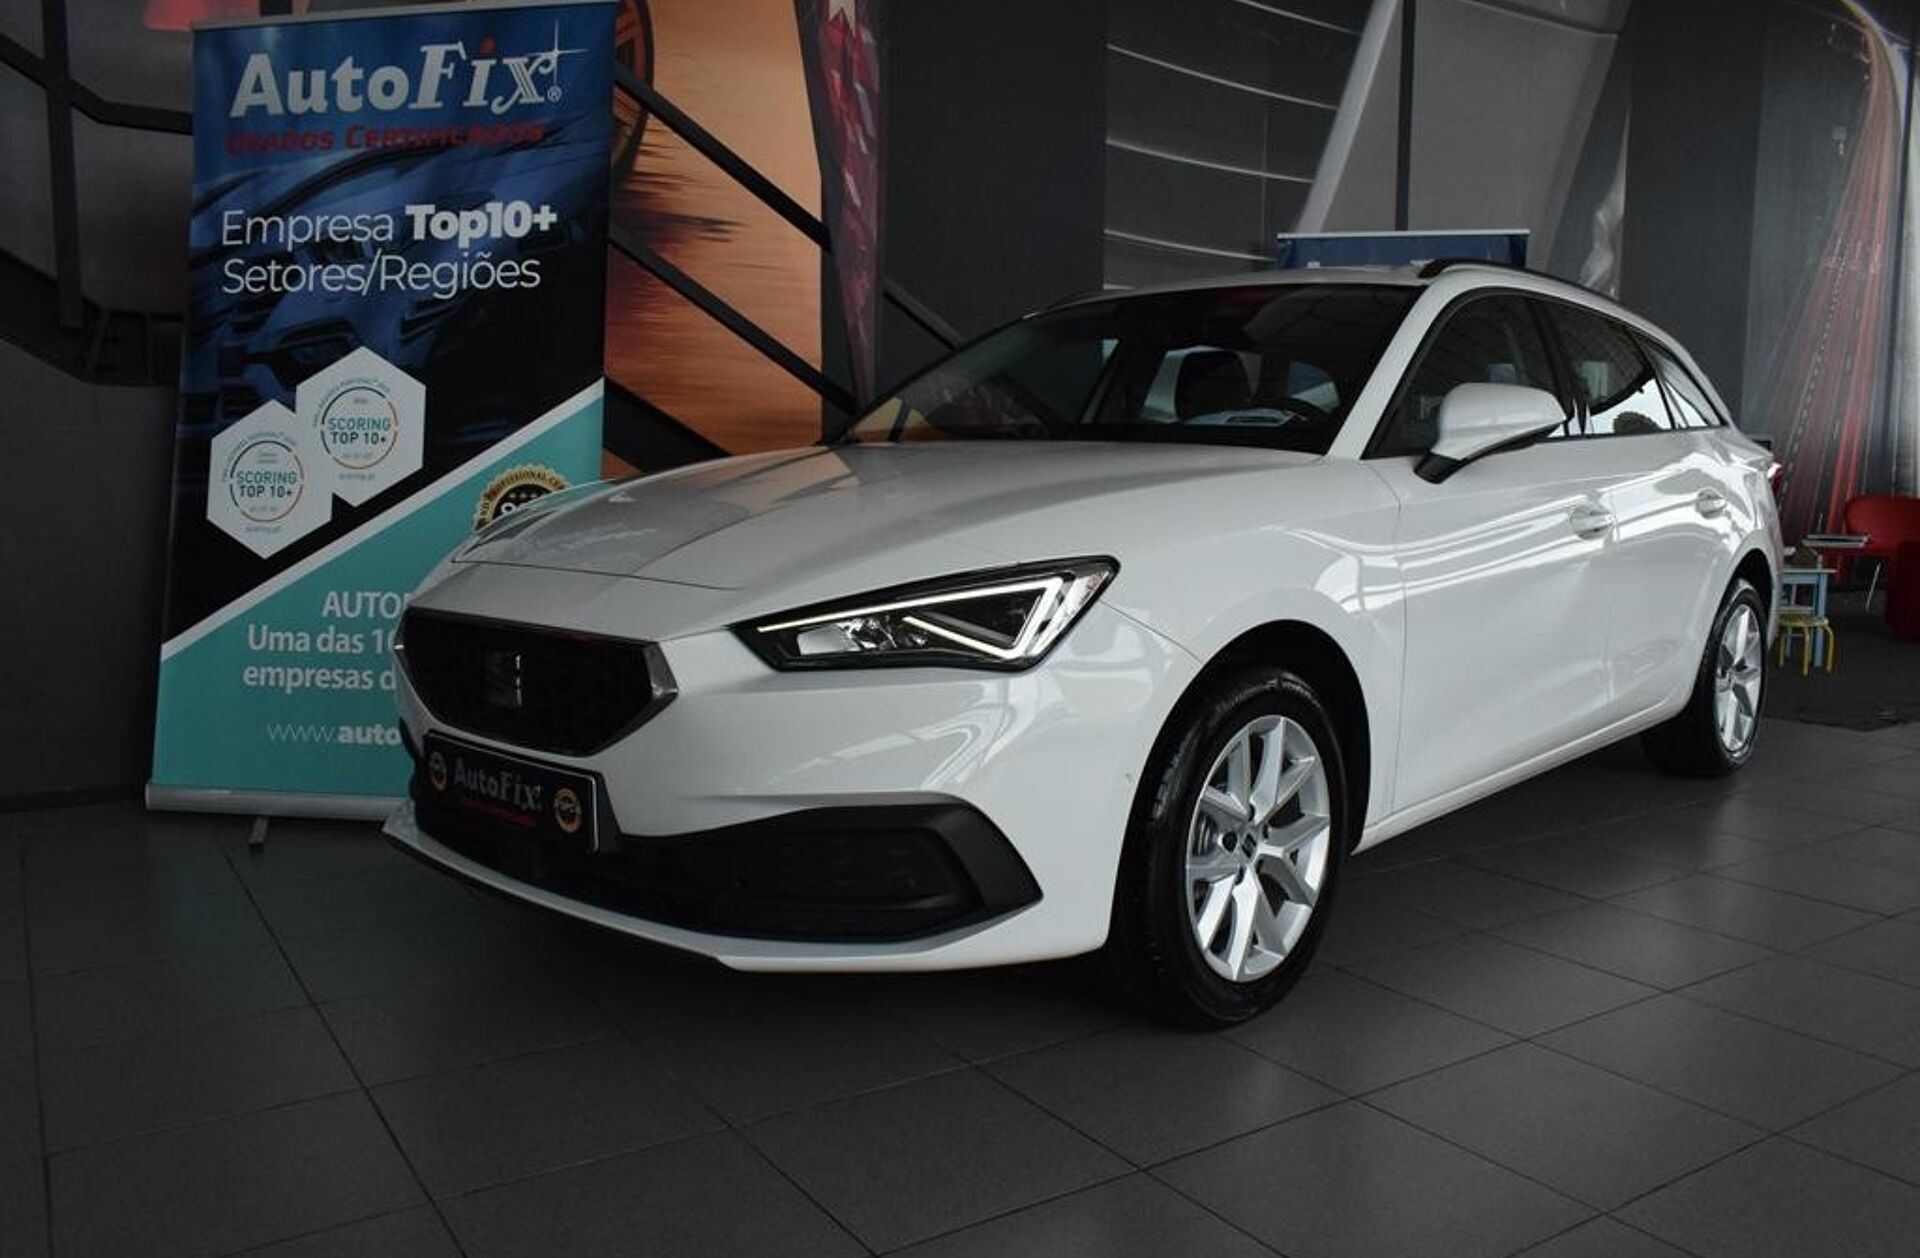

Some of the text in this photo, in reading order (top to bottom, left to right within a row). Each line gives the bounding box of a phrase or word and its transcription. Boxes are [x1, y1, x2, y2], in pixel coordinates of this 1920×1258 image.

[222, 200, 557, 251] Empresa Top10+
[222, 248, 541, 299] Setores/Regiões
[327, 417, 391, 431] SCORING
[330, 431, 359, 445] TOP
[236, 470, 298, 485] SCORING
[238, 485, 265, 497] TOP
[248, 623, 310, 651] Uma
[316, 624, 364, 654] das
[242, 665, 374, 695] empresas
[267, 723, 401, 746] www.auto
